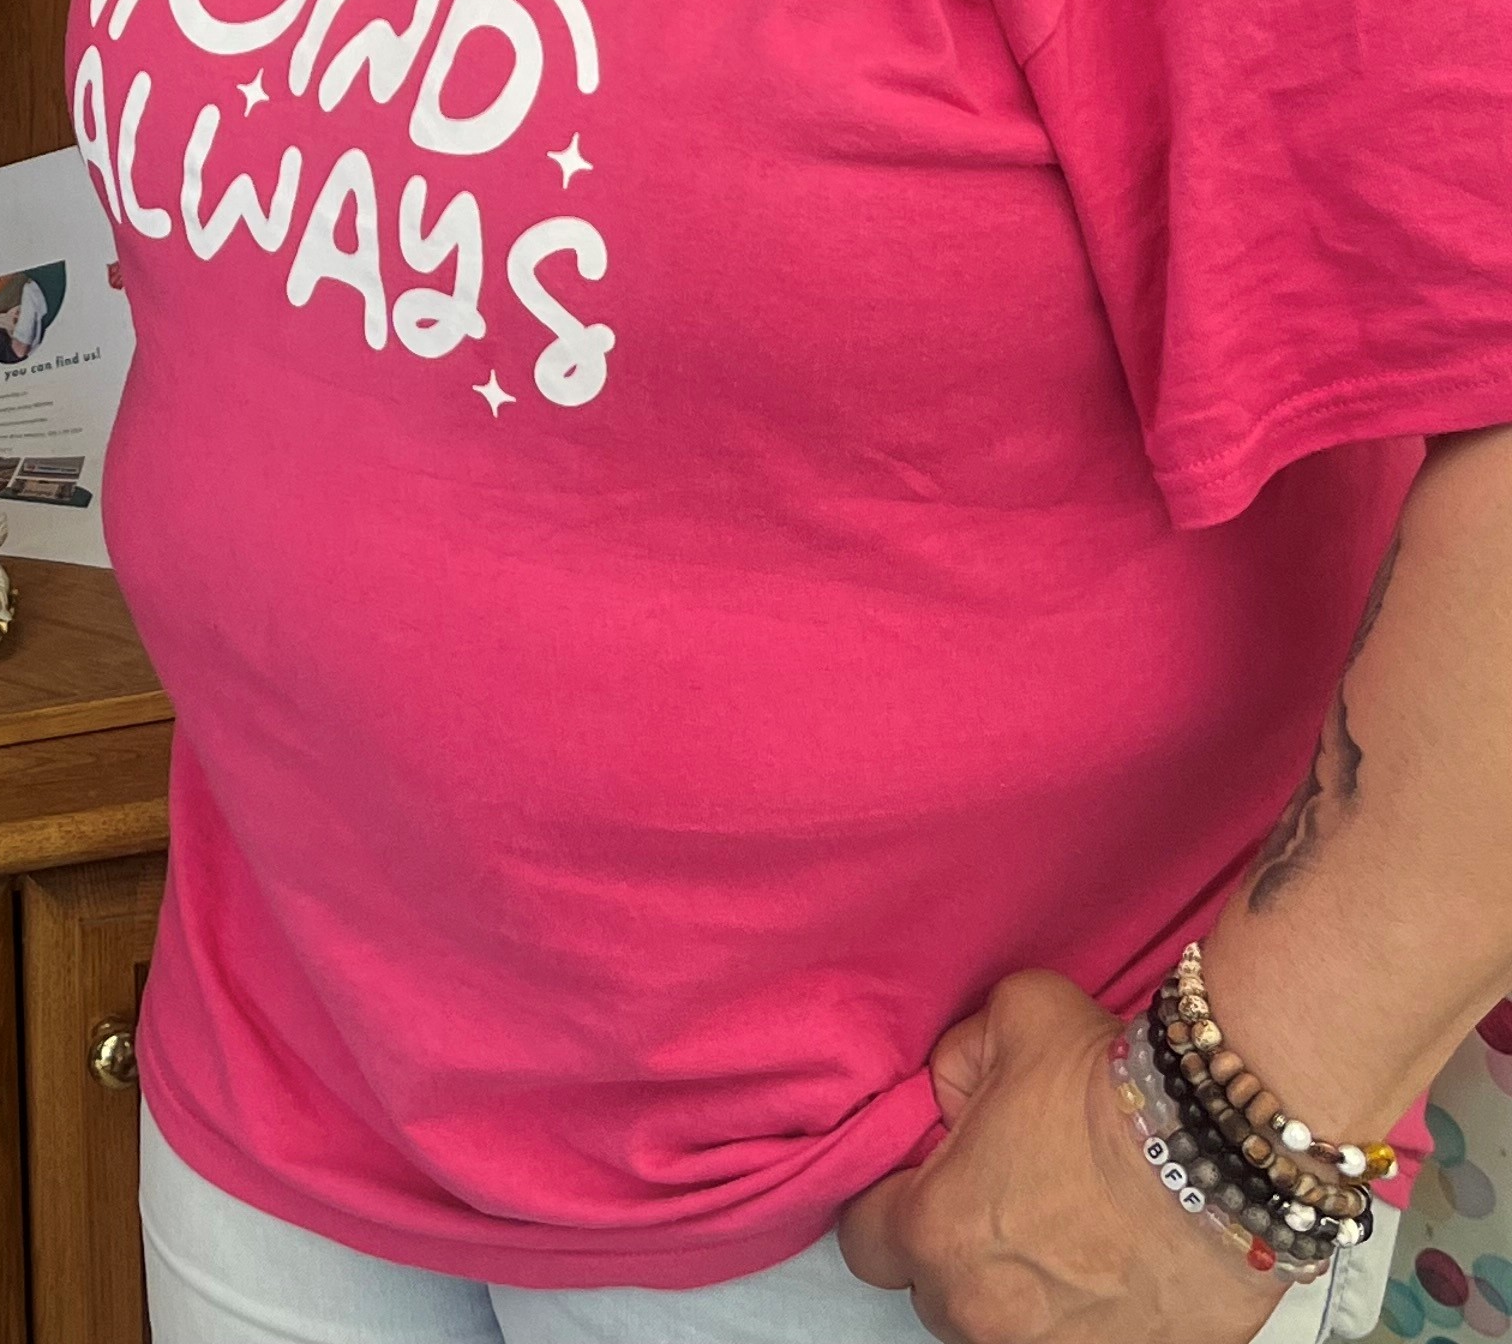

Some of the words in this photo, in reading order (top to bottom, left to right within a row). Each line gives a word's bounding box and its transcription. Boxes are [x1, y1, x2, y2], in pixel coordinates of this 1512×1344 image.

[4, 368, 27, 382] you
[31, 363, 52, 374] can
[55, 353, 79, 368] find
